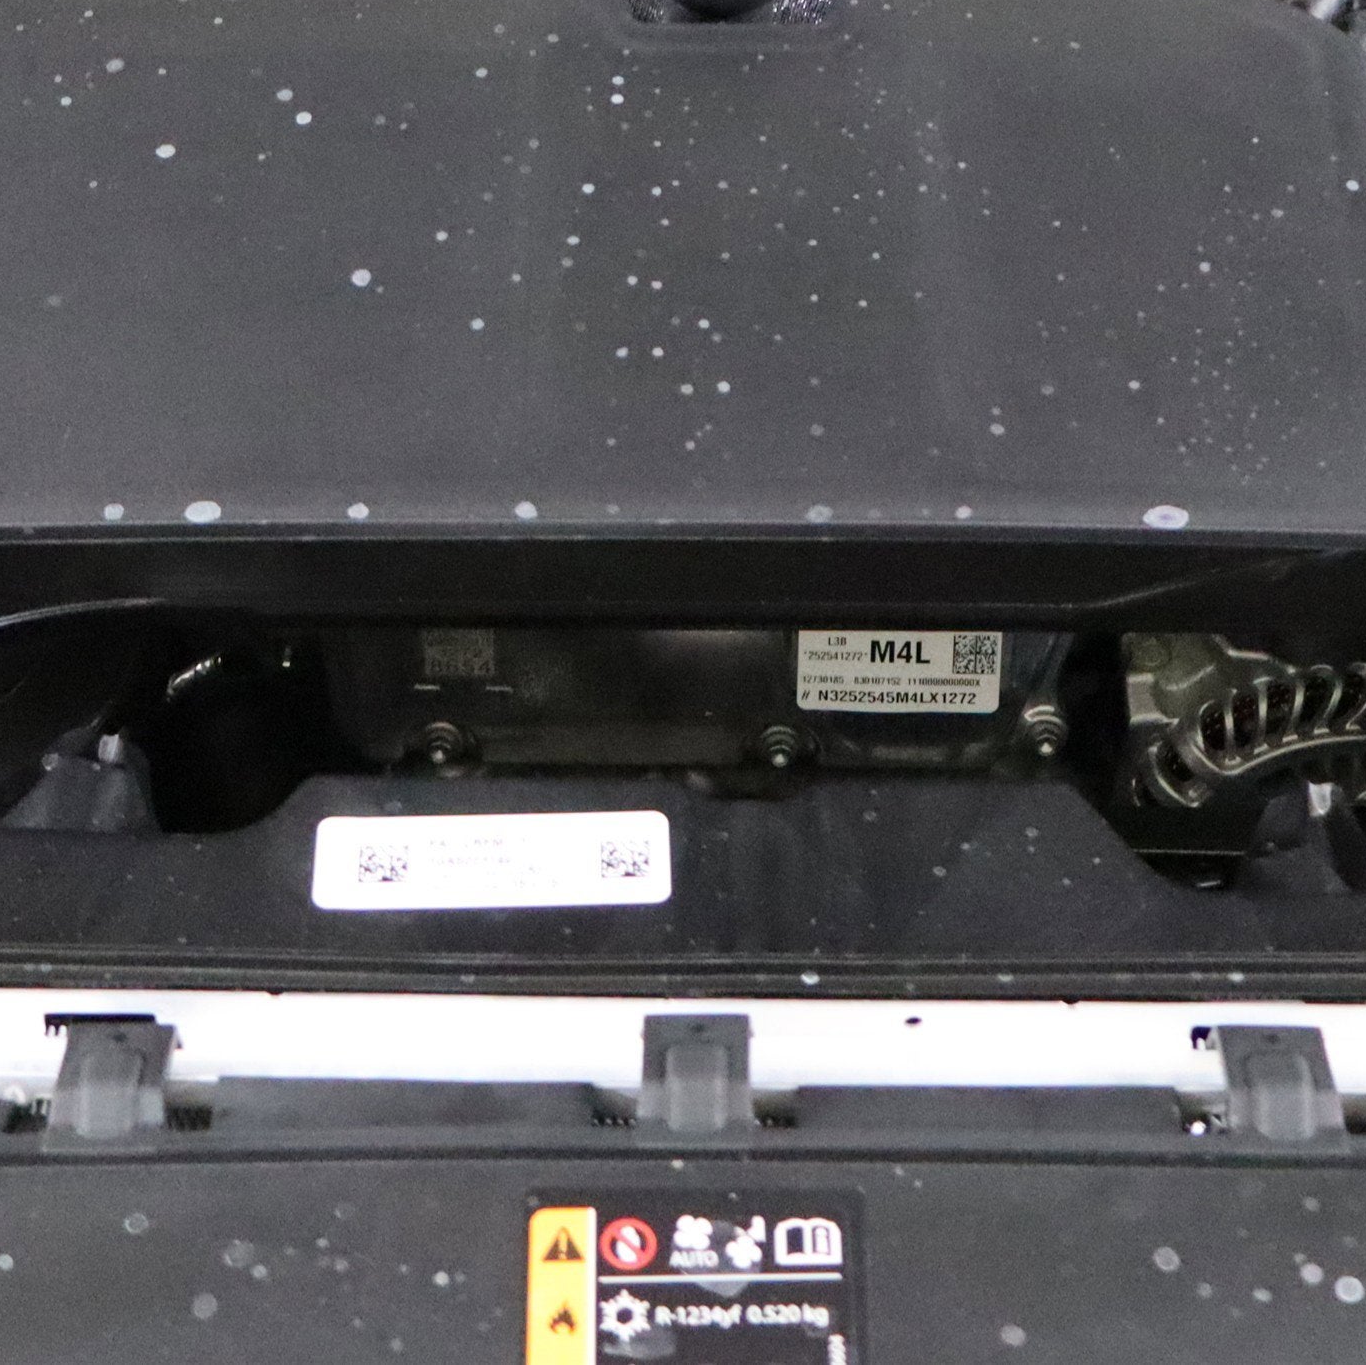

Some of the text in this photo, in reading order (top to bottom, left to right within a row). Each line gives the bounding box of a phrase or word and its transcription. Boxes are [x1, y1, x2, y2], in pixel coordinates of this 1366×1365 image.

[869, 640, 931, 664] M4L
[818, 690, 977, 704] N3252545M4LX1272
[669, 1250, 719, 1269] AUTO
[802, 1302, 830, 1329] kg
